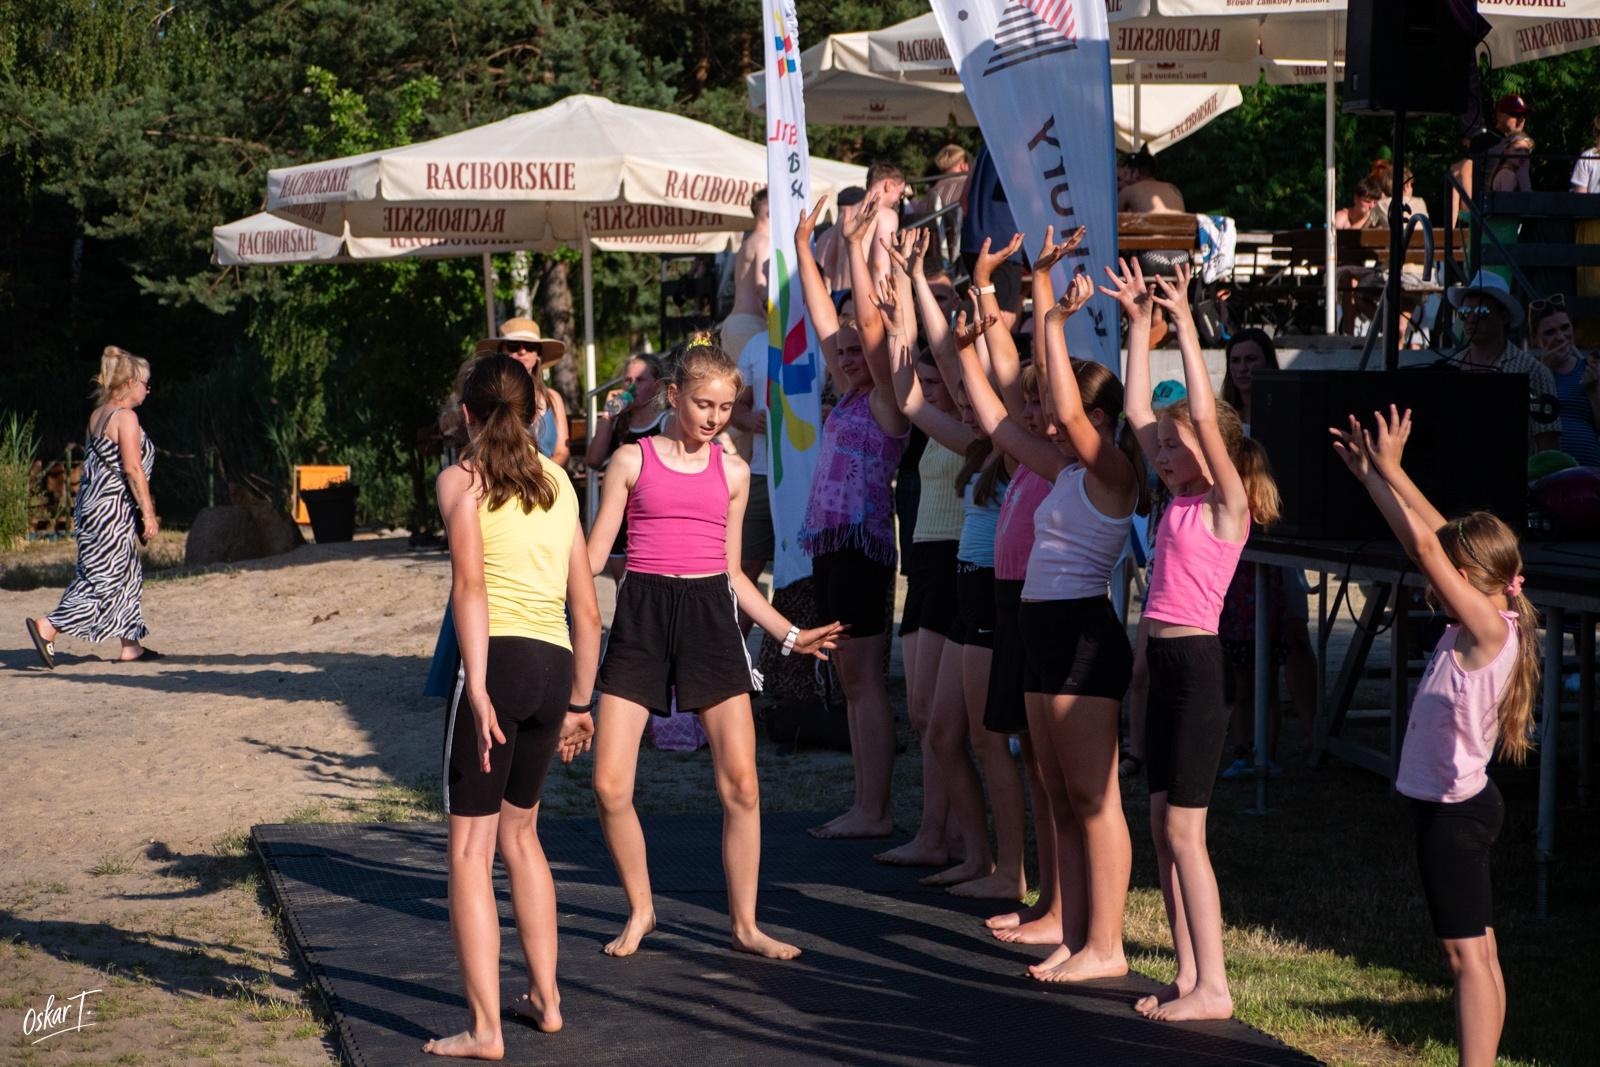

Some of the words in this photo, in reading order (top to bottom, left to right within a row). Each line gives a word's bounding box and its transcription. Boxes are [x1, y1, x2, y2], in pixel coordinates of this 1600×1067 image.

[897, 38, 951, 62] RACIBOR
[279, 165, 352, 199] RACIBORSKIE
[426, 162, 576, 190] RACIBORSKIE
[237, 229, 317, 256] RACIBORSKIE
